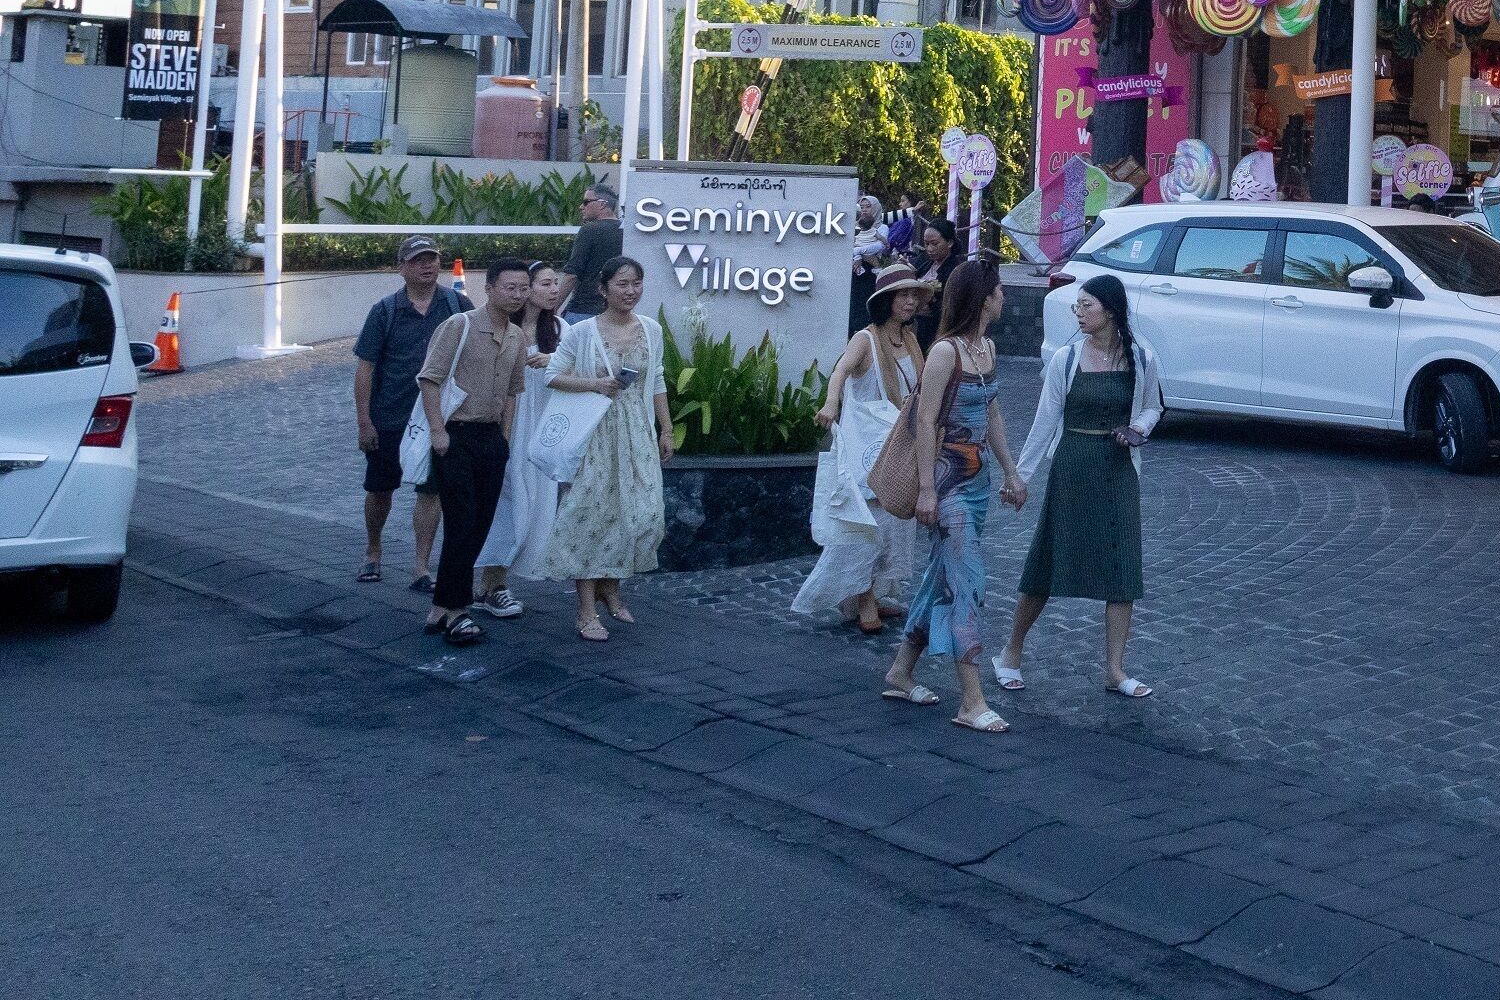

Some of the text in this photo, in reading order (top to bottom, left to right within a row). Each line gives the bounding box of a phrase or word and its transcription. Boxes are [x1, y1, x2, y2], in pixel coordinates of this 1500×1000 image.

[144, 28, 190, 42] NOW OPEN
[771, 37, 881, 48] MAXIMUM CLEARANCE
[1054, 38, 1090, 57] IT'S
[131, 43, 199, 72] STEVE
[129, 69, 197, 91] MADDEN
[1097, 77, 1162, 92] candylicious
[1298, 72, 1353, 90] candylicio
[958, 149, 996, 175] Selfie
[1396, 159, 1451, 185] Selfie
[1420, 181, 1448, 189] corner
[634, 196, 846, 244] Seminyak
